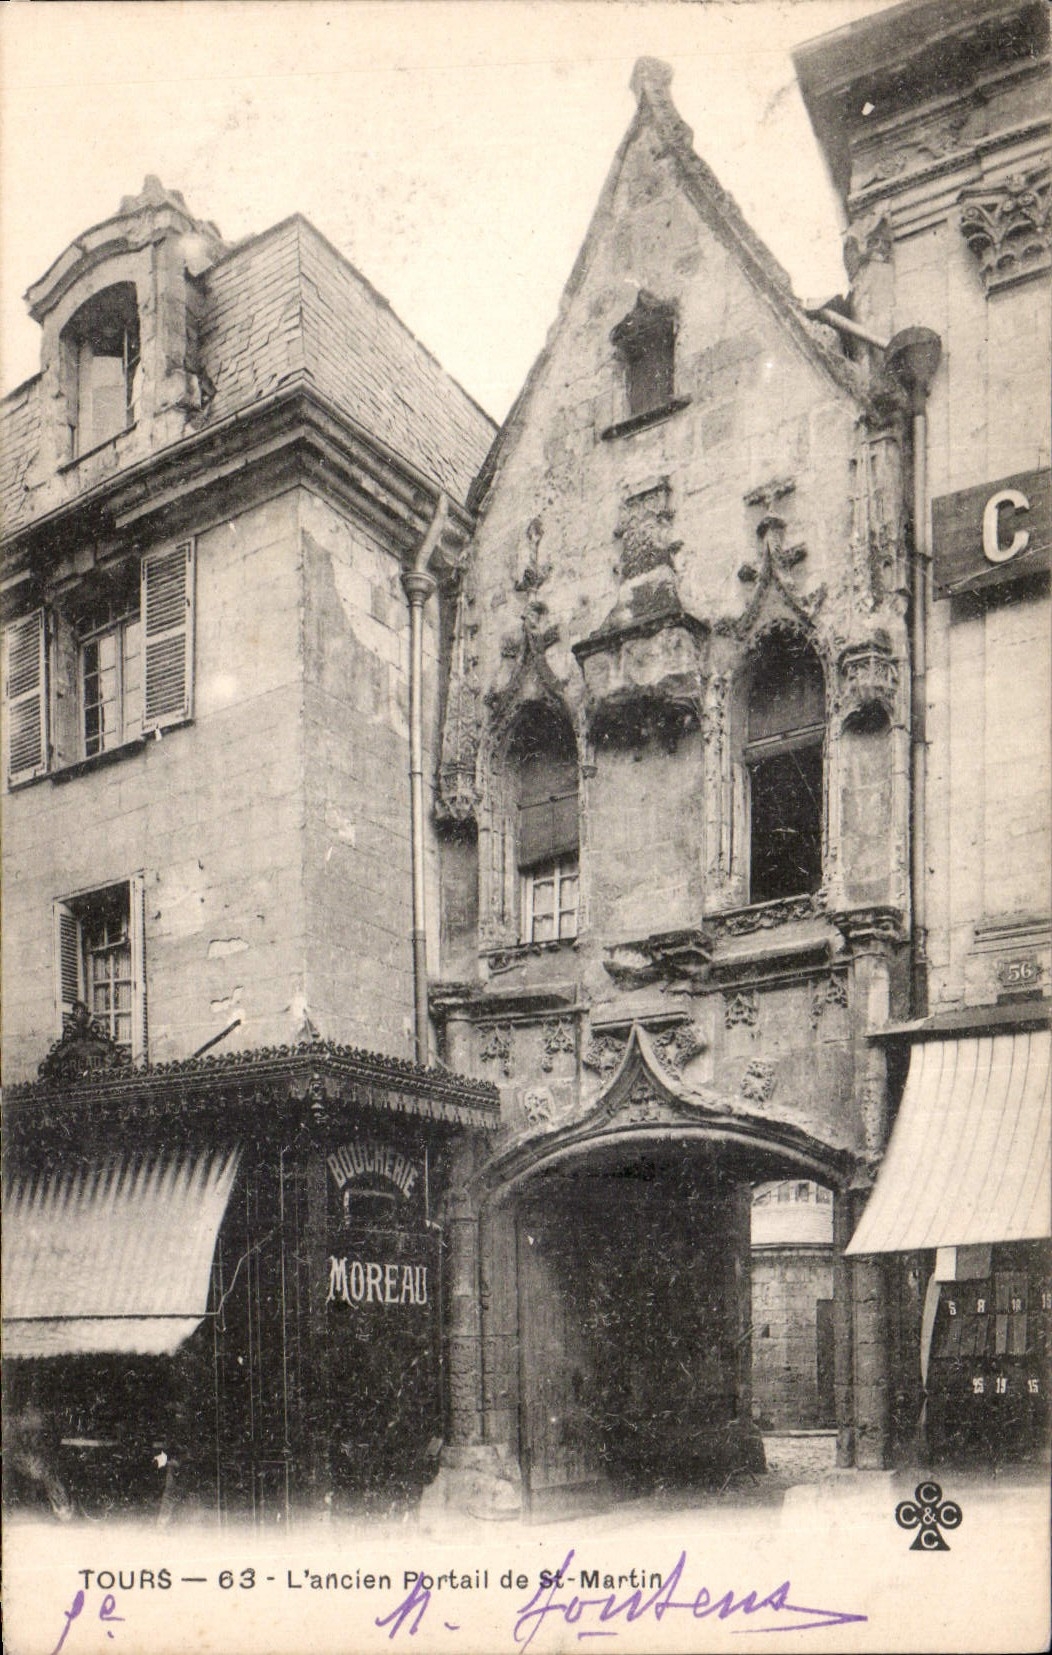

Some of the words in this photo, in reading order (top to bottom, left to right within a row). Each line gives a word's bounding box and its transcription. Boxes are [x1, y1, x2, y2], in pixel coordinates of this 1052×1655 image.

[1007, 961, 1032, 982] 56
[326, 1142, 419, 1198] BOUCHERIE
[326, 1254, 428, 1309] MOREAU
